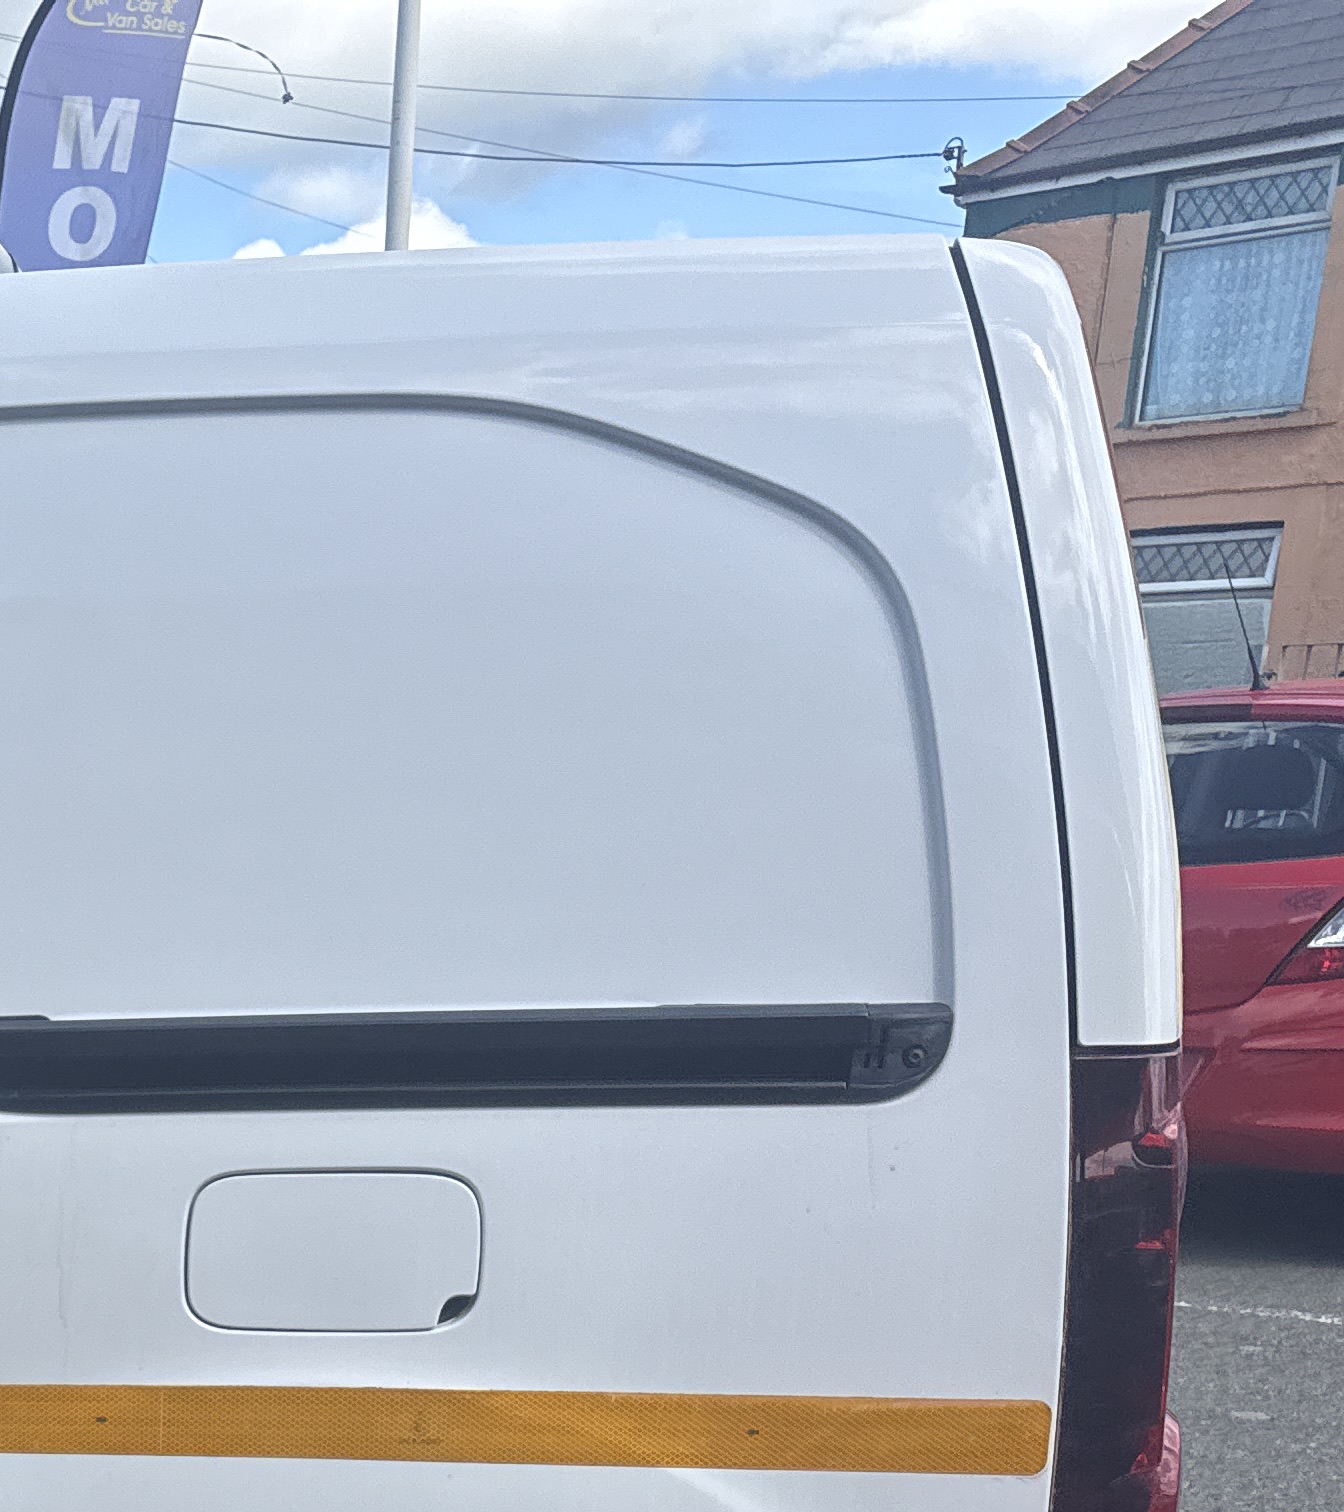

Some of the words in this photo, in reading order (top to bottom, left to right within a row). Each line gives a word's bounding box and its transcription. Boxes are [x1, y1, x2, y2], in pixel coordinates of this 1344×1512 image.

[125, 0, 158, 12] Car
[107, 12, 137, 29] Van
[141, 14, 186, 33] Sales
